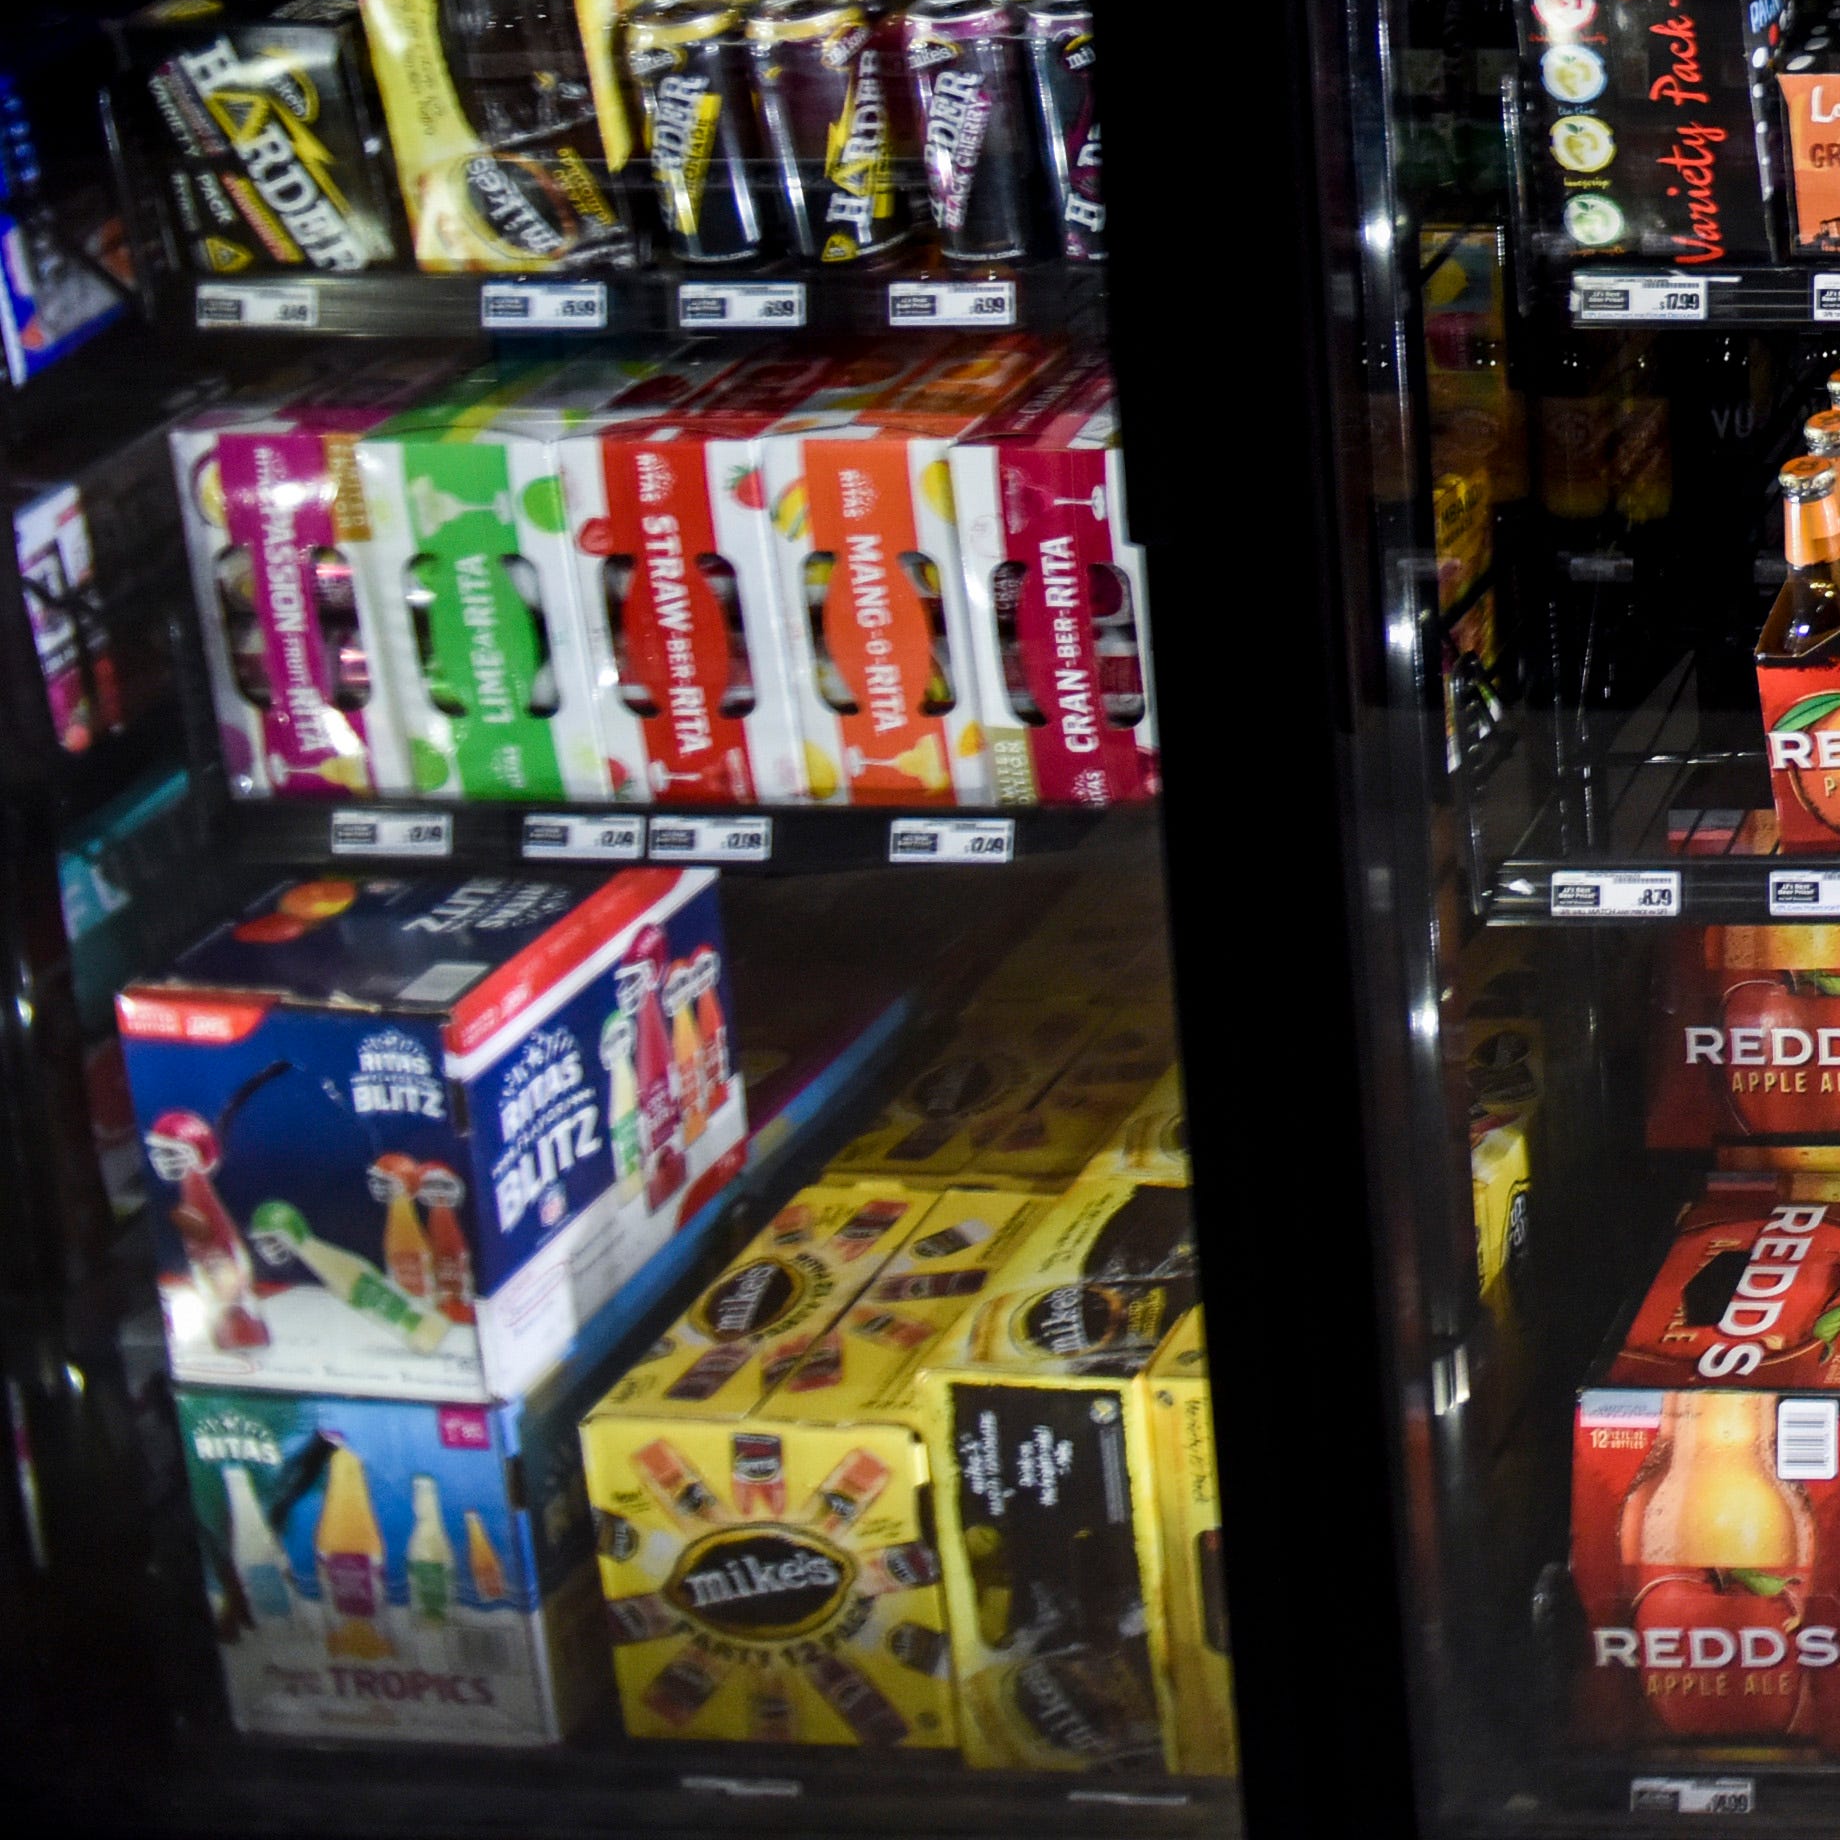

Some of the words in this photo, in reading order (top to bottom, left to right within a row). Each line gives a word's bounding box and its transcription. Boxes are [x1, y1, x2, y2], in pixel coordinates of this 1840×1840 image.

[1649, 15, 1710, 105] Pack
[1665, 122, 1726, 265] Variety
[458, 552, 512, 726] LIME-A-RITA
[640, 512, 714, 757] STRAW-BER-RITA
[852, 532, 906, 736] MANG-O-RITA
[1039, 534, 1102, 755] CRAN-BER-RITA
[686, 1551, 839, 1608] mike's
[329, 1667, 495, 1708] TROPICS
